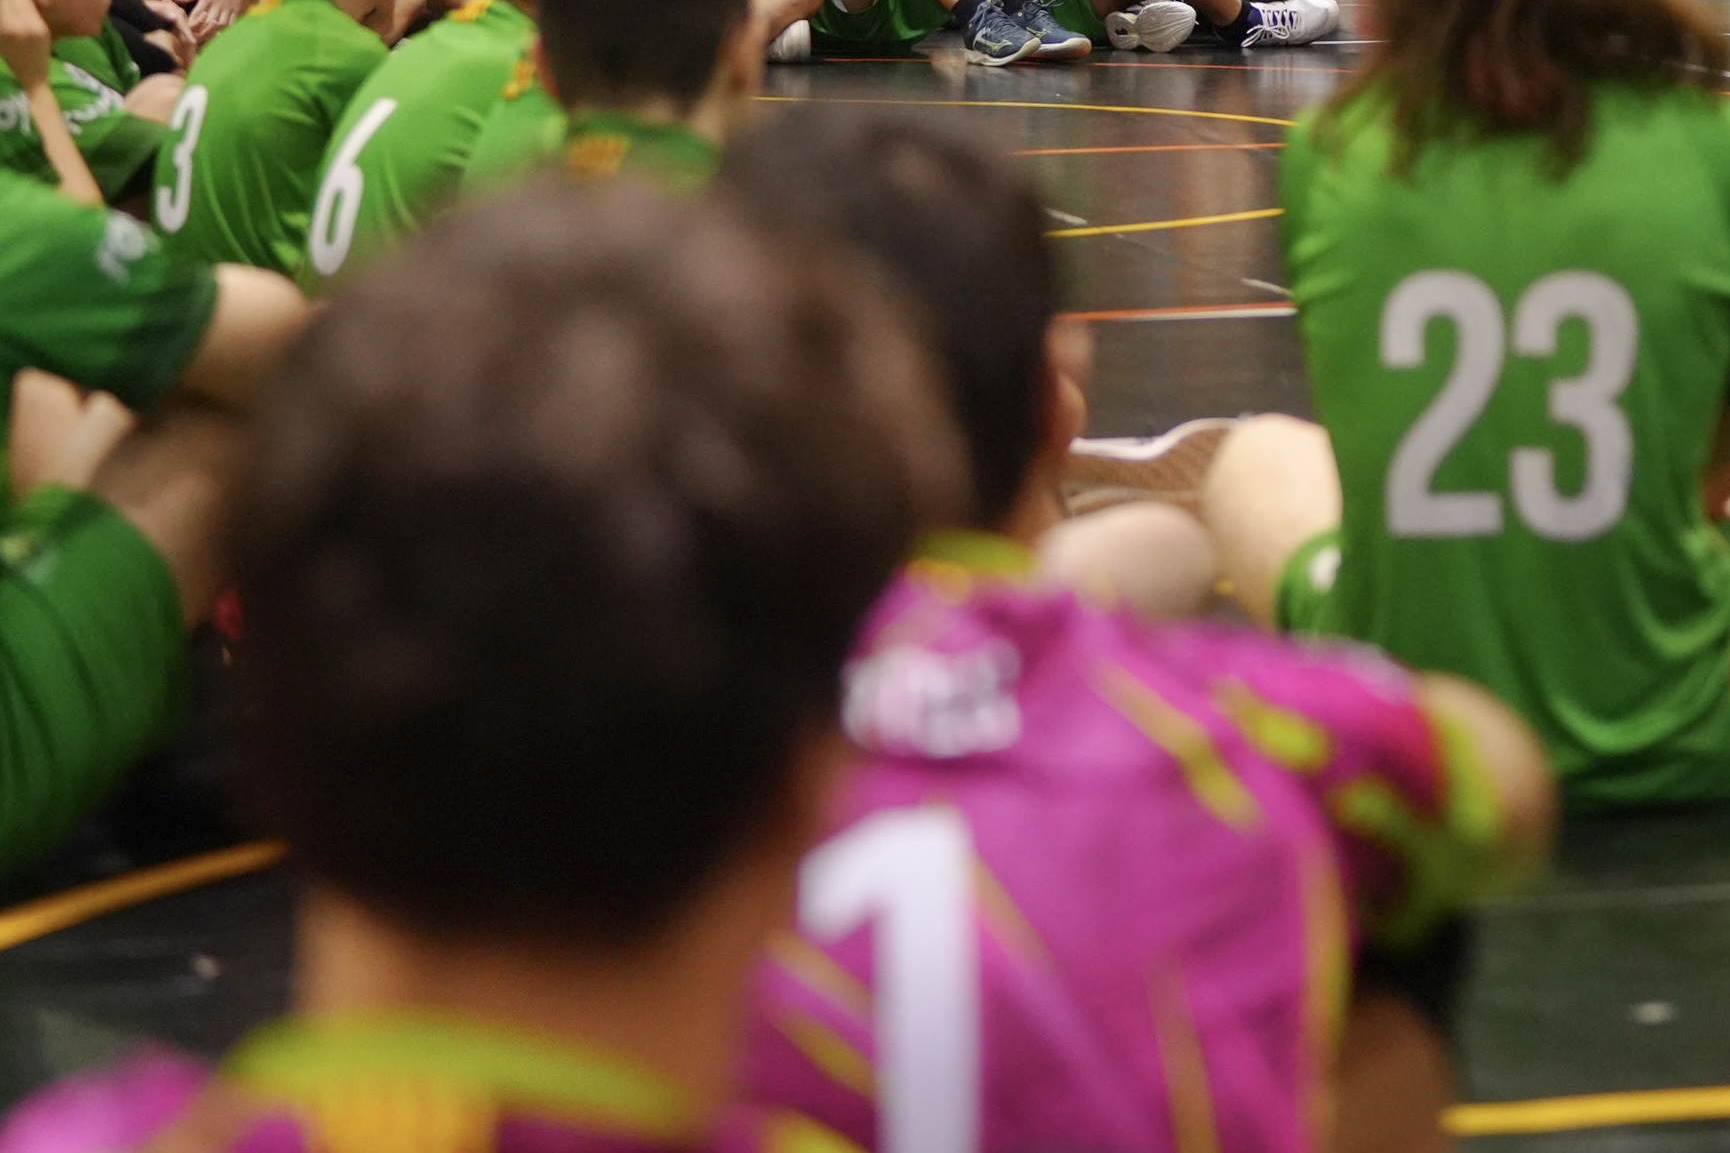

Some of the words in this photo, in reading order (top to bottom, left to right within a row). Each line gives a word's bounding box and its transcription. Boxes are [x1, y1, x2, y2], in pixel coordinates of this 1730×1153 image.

[156, 85, 209, 234] 3
[309, 98, 397, 276] 6
[1379, 268, 1640, 542] 23
